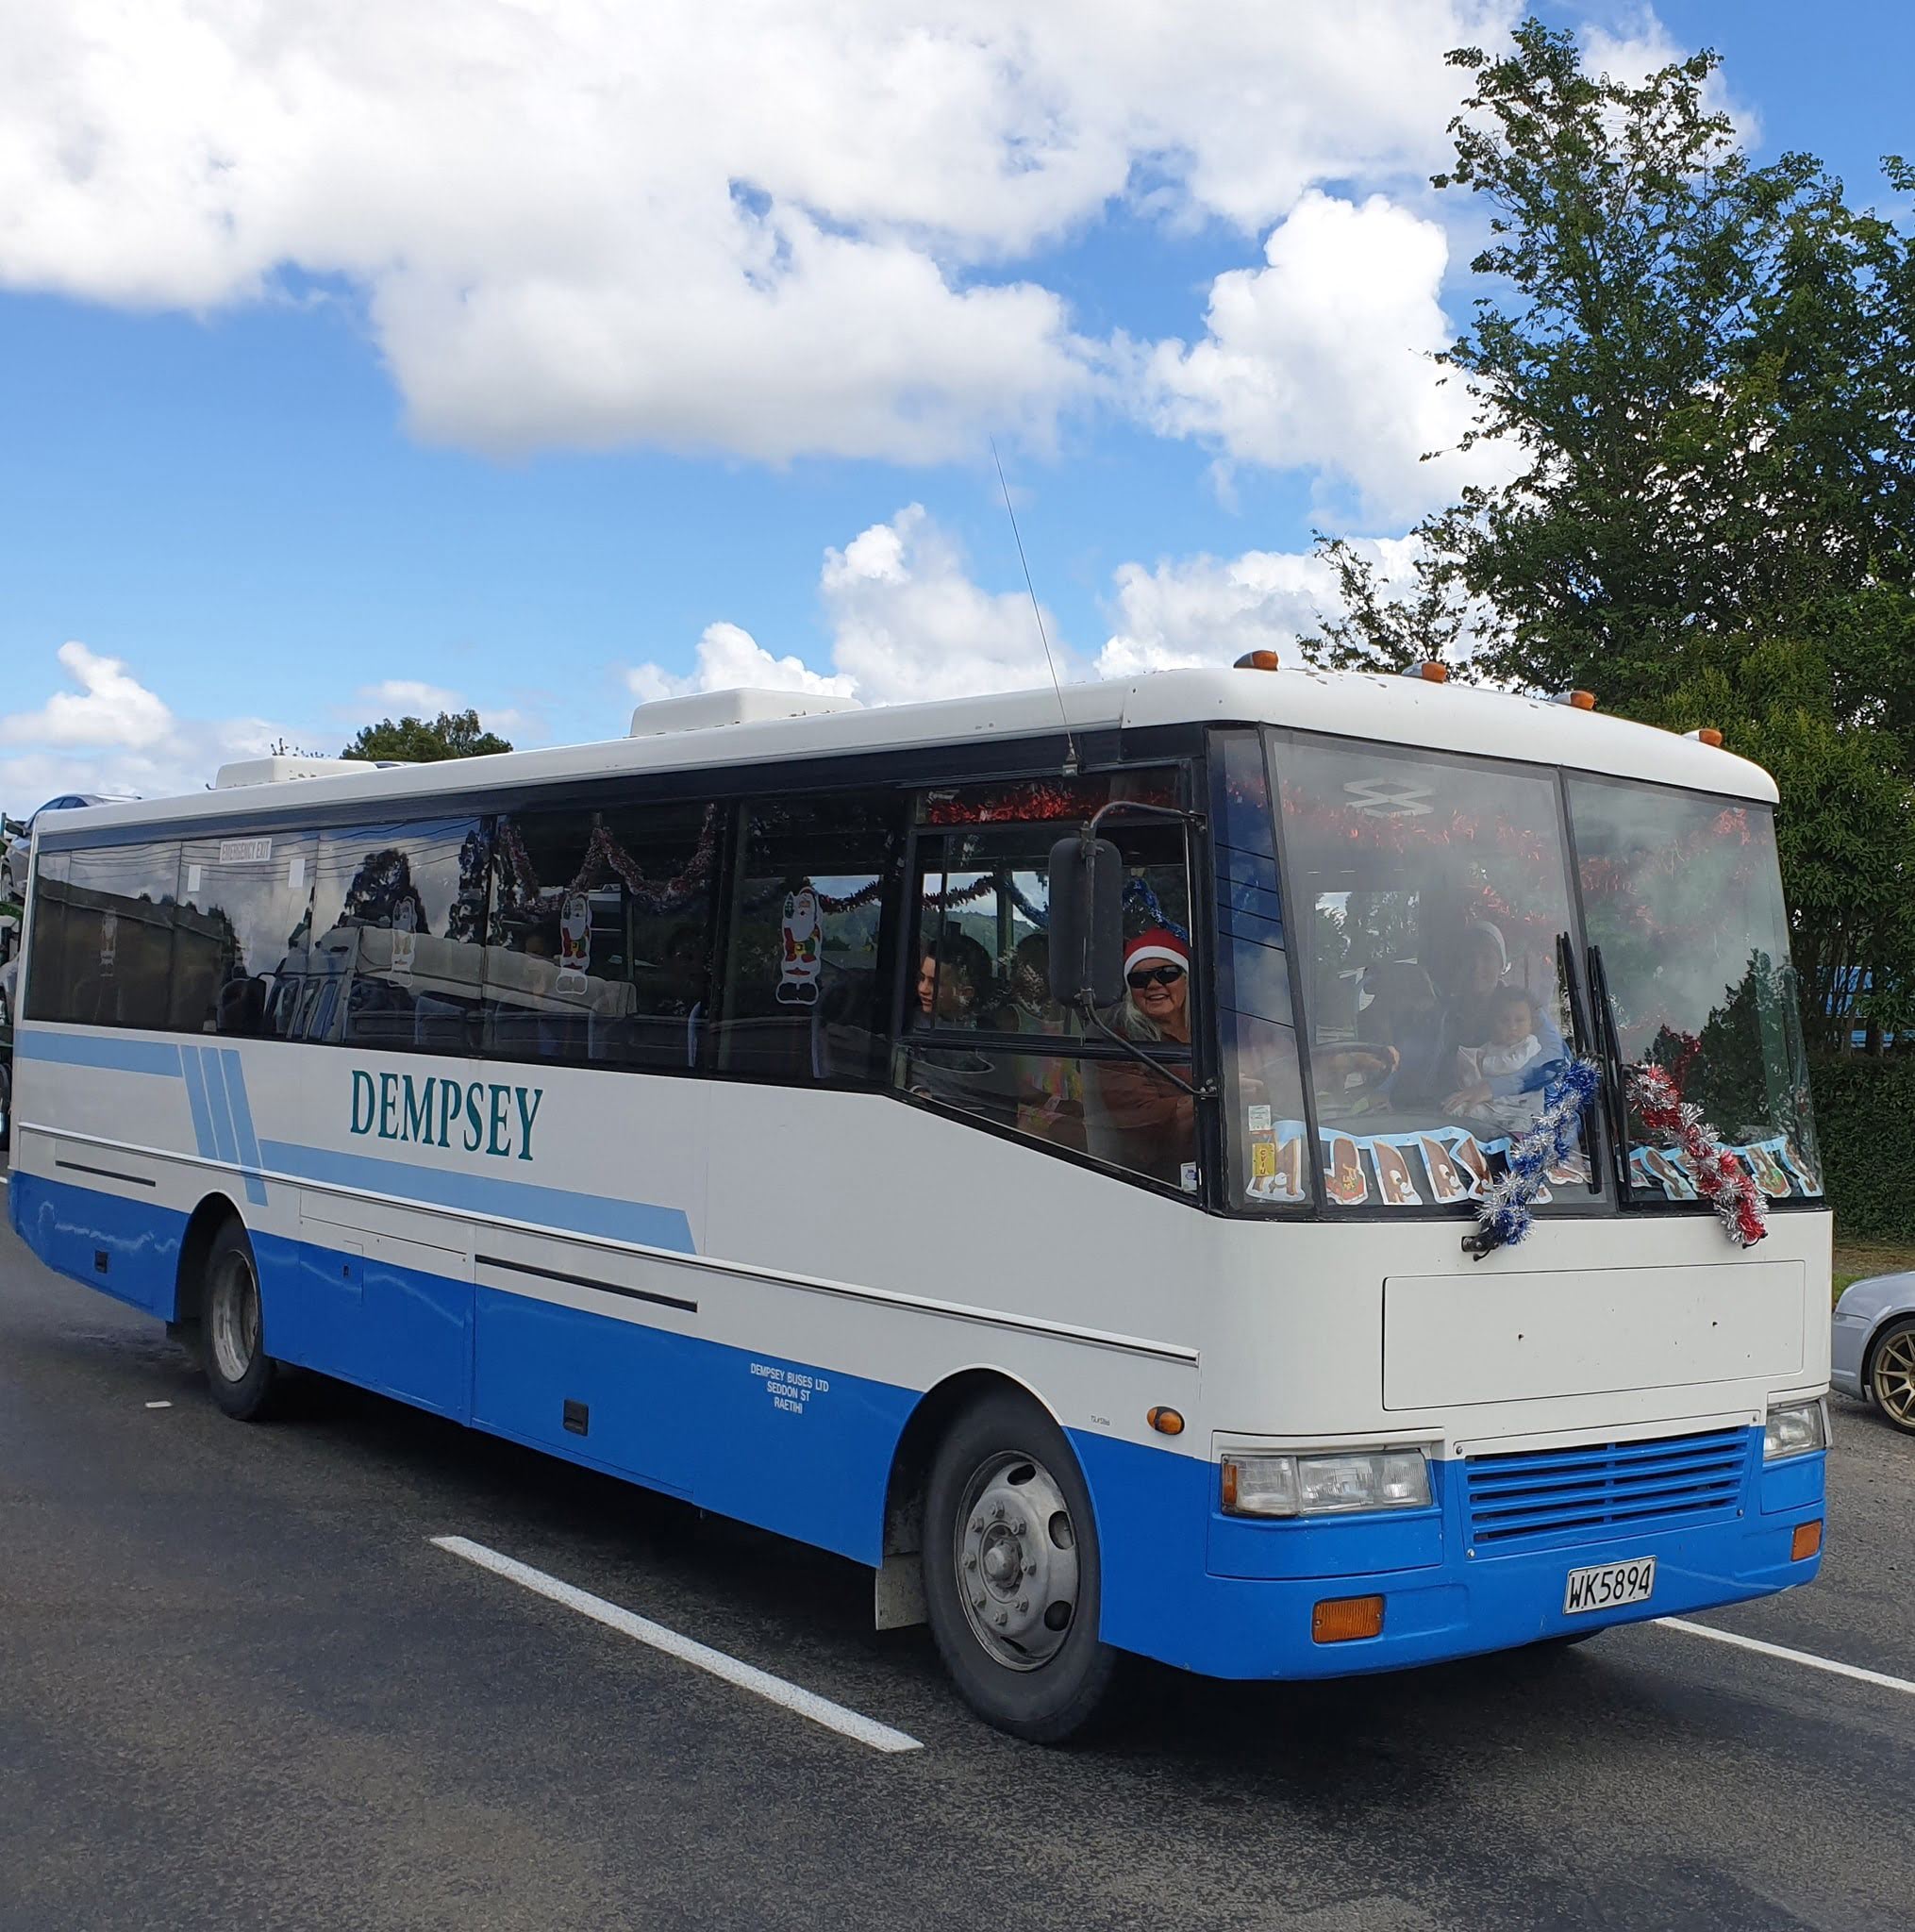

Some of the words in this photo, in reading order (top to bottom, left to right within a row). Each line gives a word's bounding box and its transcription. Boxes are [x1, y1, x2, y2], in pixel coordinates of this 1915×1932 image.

[257, 841, 270, 859] EXIT
[350, 1070, 543, 1161] DEMPSEY
[750, 1362, 785, 1381] DEMPSEY
[787, 1372, 813, 1389] BUSES
[815, 1378, 829, 1392] LTD
[767, 1380, 798, 1399] SEDDON
[800, 1390, 811, 1402] ST
[774, 1396, 803, 1414] RAETIHI
[1568, 1563, 1652, 1609] WK5894
